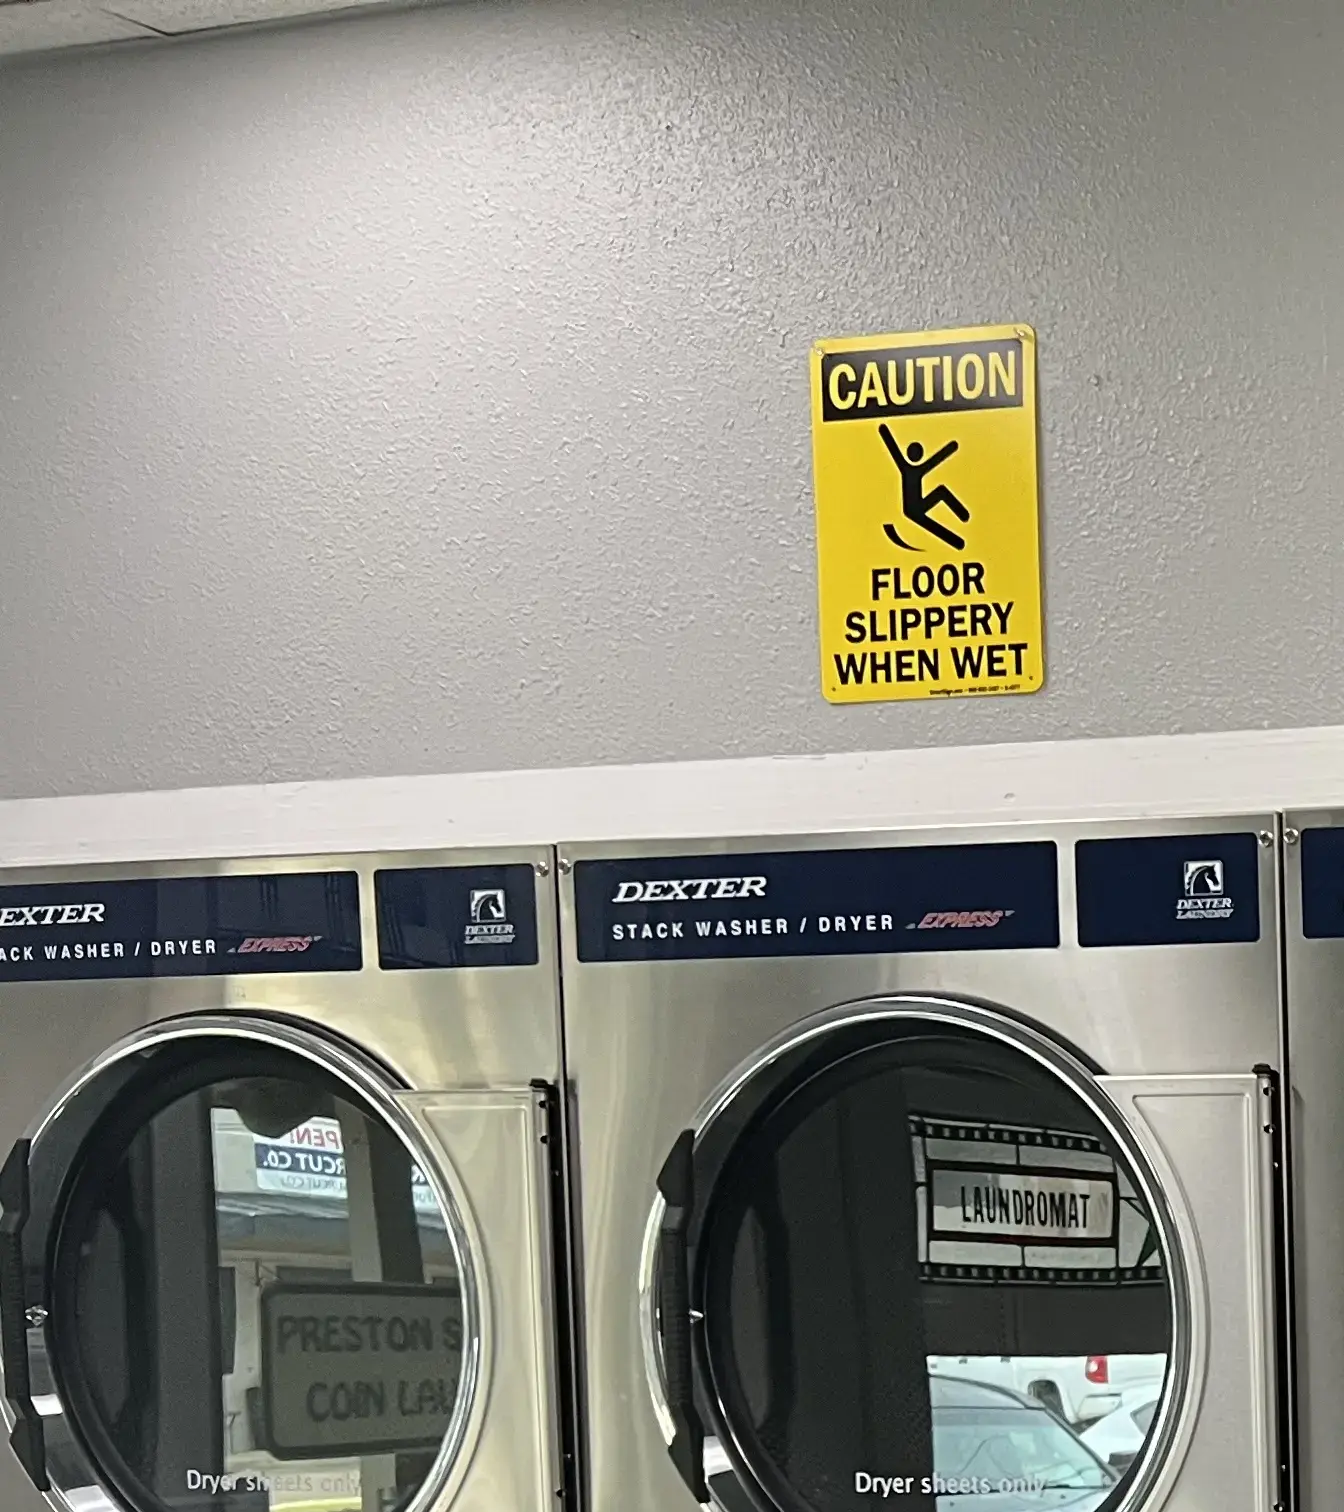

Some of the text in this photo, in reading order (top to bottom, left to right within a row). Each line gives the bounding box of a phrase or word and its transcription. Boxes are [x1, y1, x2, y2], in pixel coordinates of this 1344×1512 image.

[828, 349, 1017, 411] CAUTION
[871, 562, 985, 600] FLOOR
[845, 602, 1014, 644] SLIPPERY
[834, 643, 1028, 685] WHEN WET
[612, 875, 768, 903] DEXTER
[1177, 898, 1232, 909] DEXTER
[0, 903, 106, 926] EXTER
[612, 917, 685, 941] STACK
[695, 915, 790, 938] WASHER
[819, 913, 894, 934] DRYER
[917, 909, 1004, 930] EXPRESS
[0, 943, 34, 962] ACK
[45, 941, 125, 960] WASHER
[151, 939, 217, 956] DRYER
[960, 1185, 1090, 1229] LAUNDROMAT
[277, 1315, 434, 1352] PRESTON
[187, 1470, 238, 1494] Dryer
[855, 1472, 914, 1497] Dryer
[921, 1472, 990, 1494] sheets
